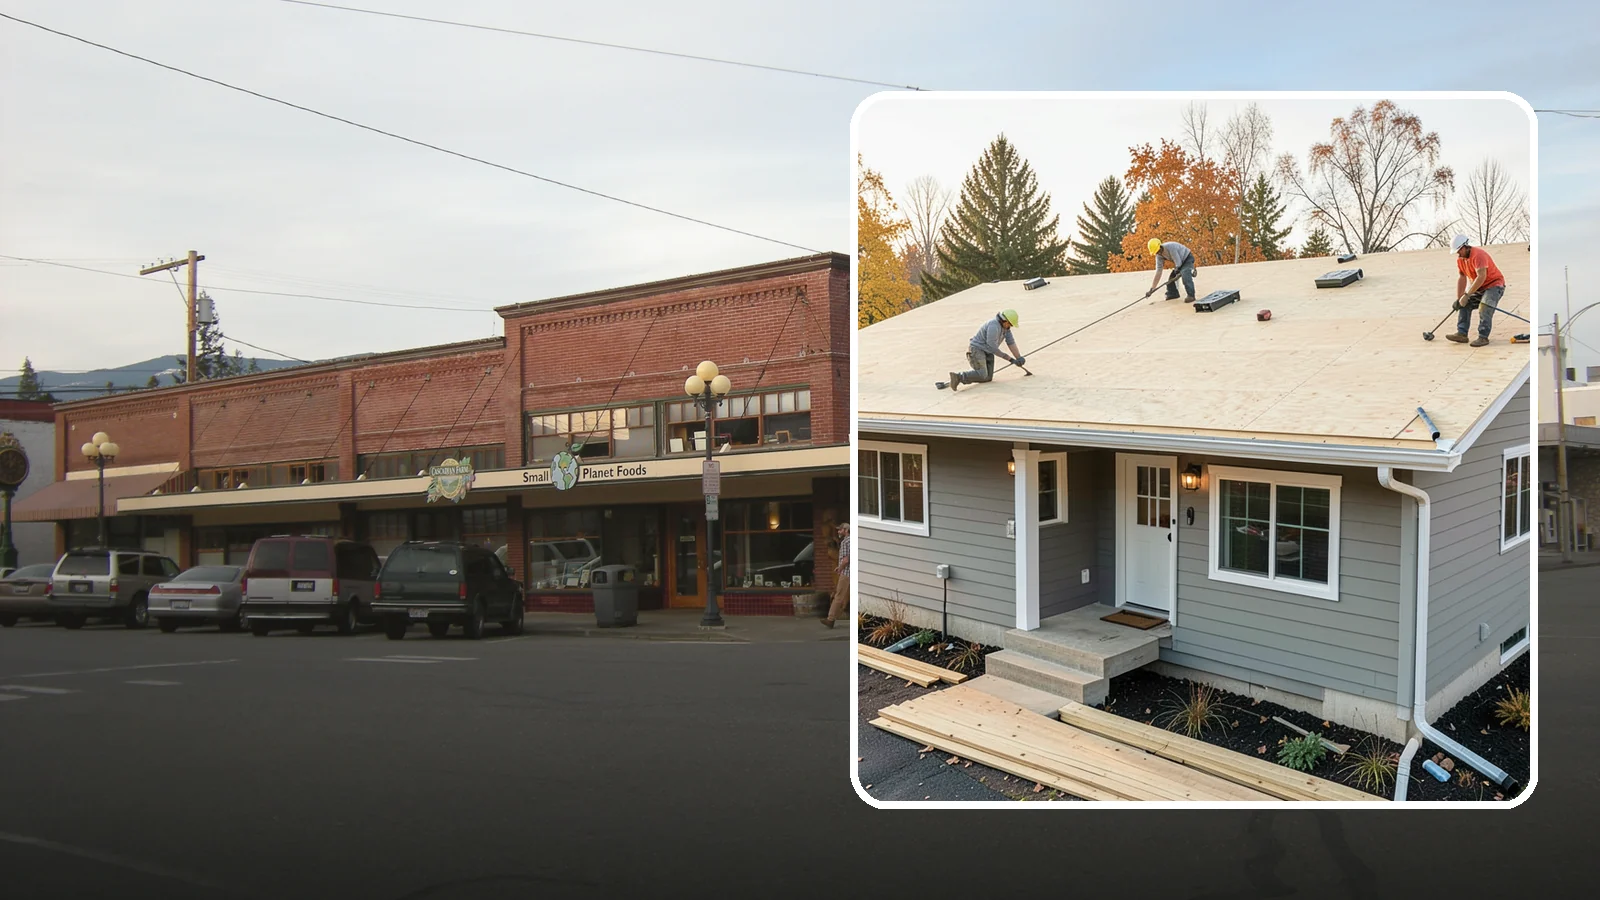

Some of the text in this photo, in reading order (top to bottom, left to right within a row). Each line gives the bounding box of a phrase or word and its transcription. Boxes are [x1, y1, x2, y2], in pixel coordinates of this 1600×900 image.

[523, 464, 647, 483] Small Planet Foods
